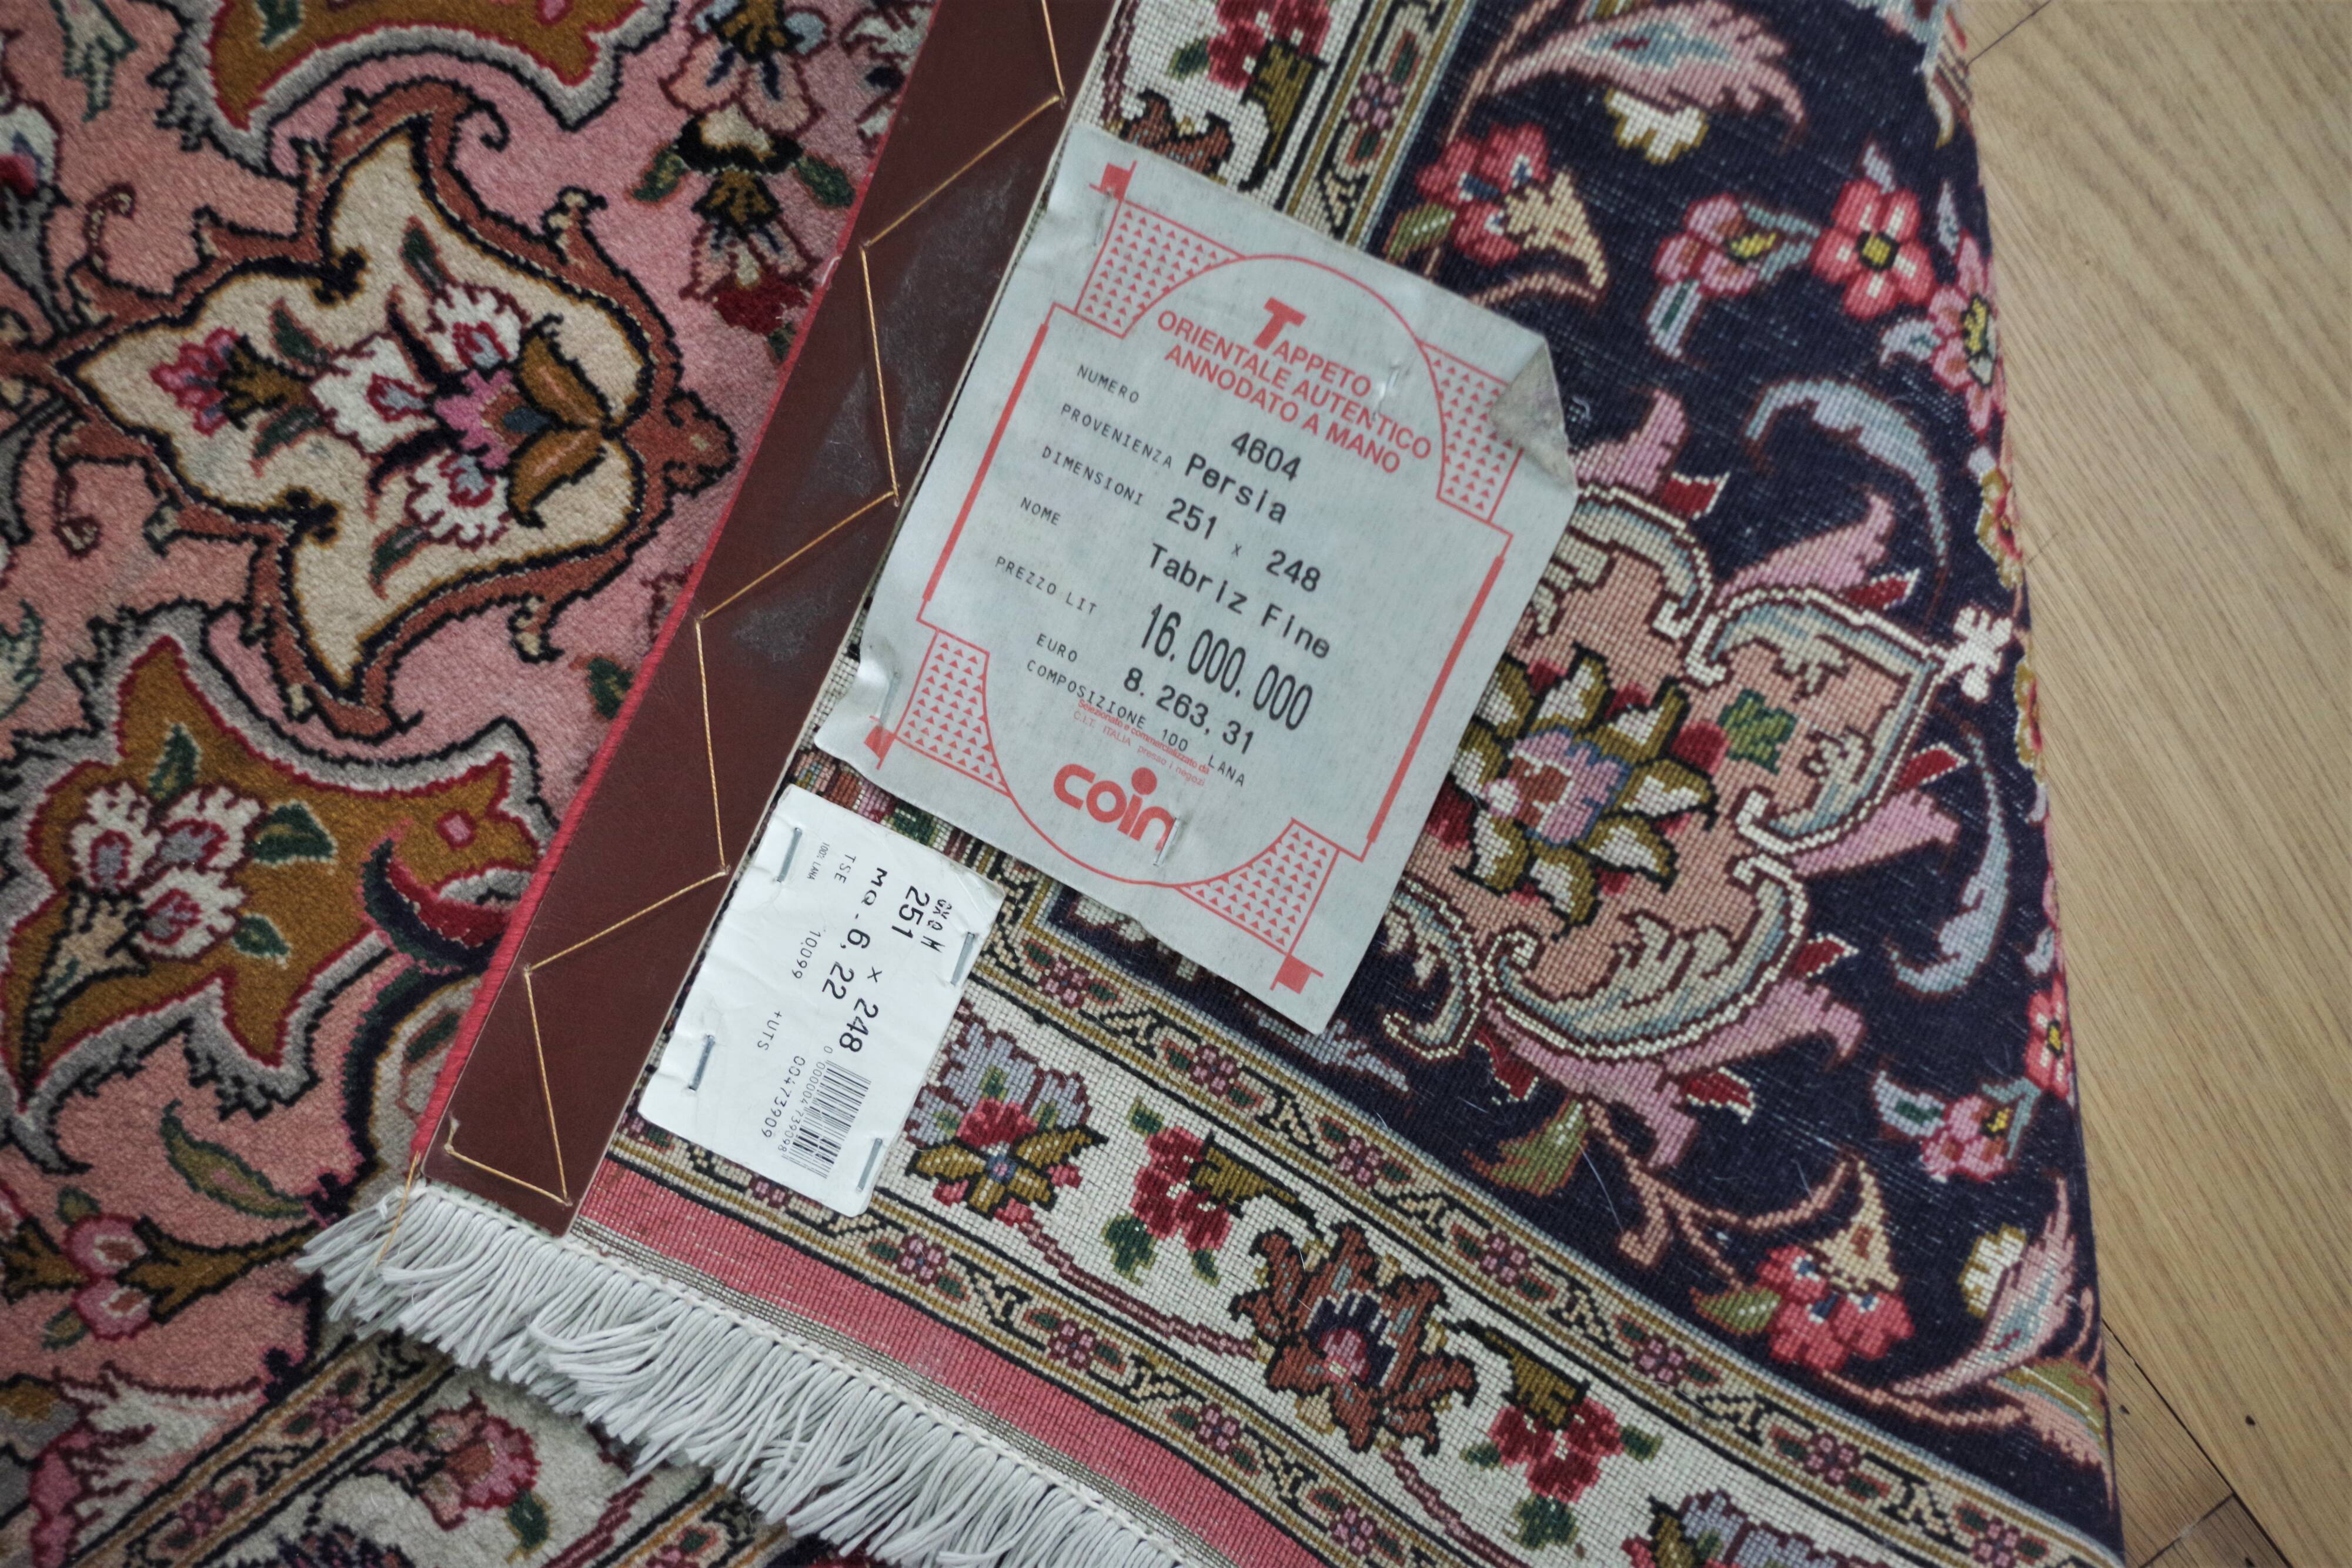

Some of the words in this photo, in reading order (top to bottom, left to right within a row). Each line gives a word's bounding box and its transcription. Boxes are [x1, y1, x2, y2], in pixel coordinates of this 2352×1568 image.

[1253, 297, 1371, 397] TAPPETO
[1157, 310, 1292, 390] ORIENTALE
[1294, 379, 1431, 459] AUTENTICO
[1164, 345, 1299, 422] ANNODATO
[1301, 413, 1319, 435] A
[1325, 422, 1401, 473] MANO
[1077, 365, 1140, 404] NUMERO
[1231, 431, 1302, 482] 4604
[1060, 403, 1173, 469] PROVENIENZA
[1184, 452, 1287, 524] Persia
[1041, 445, 1143, 507] DIMENSIONI
[1166, 497, 1218, 540] 251
[1266, 549, 1321, 593] 248
[994, 556, 1057, 596] PREZZO
[1065, 591, 1098, 616] LIT
[1020, 496, 1061, 526] NOME
[1149, 543, 1248, 615] Tabriz
[1260, 603, 1331, 659] Fine
[1035, 633, 1078, 663] EURO
[1027, 660, 1147, 730] COMPOSIZIONE
[1161, 728, 1188, 752] 100
[1207, 755, 1245, 787] LANA
[1078, 698, 1124, 729] Selezionato
[1102, 726, 1131, 747] ITALIA
[1137, 745, 1167, 765] presso
[1175, 766, 1205, 787] negozi
[1053, 763, 1177, 851] coin
[807, 861, 820, 881] LANA
[817, 842, 830, 860] 100%
[834, 854, 857, 884] TSE
[891, 885, 930, 938] 251
[757, 1011, 782, 1051] +UTS
[839, 998, 878, 1052] 248
[761, 1056, 806, 1138] 00473909
